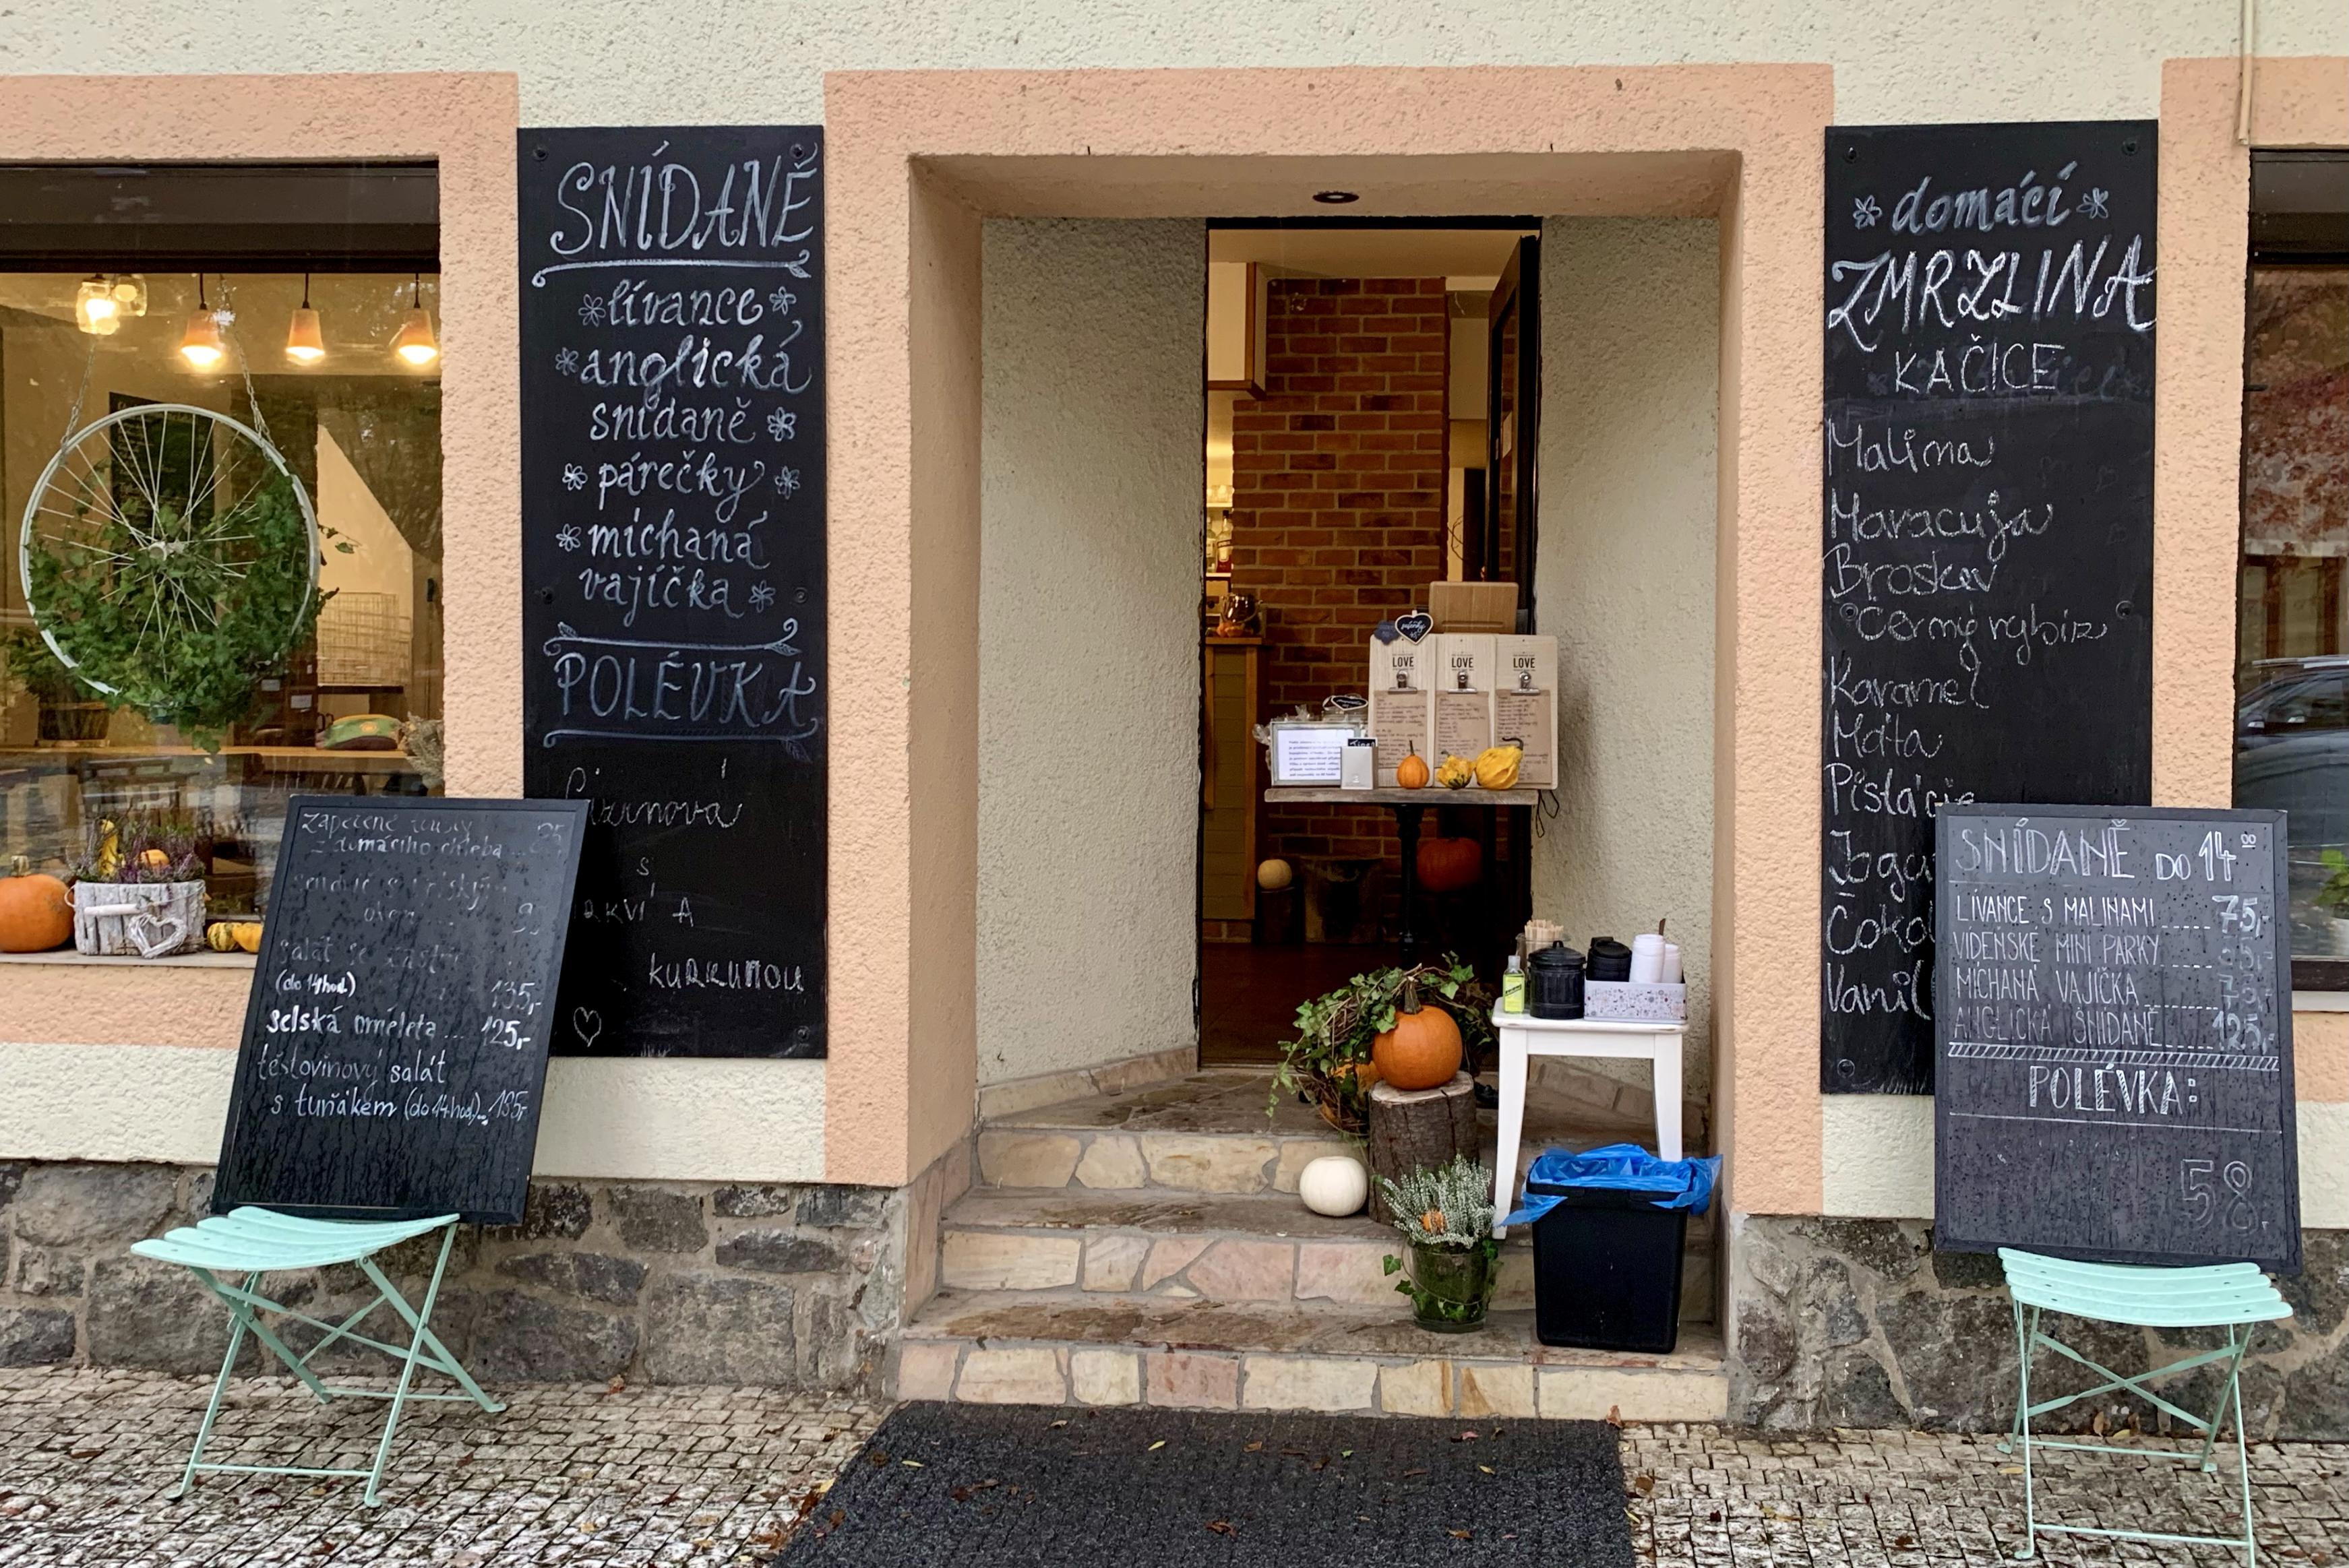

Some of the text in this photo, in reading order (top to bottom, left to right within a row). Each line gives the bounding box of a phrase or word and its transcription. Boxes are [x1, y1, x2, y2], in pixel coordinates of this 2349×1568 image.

[550, 141, 818, 254] SNÍDANĚ
[608, 279, 763, 326] lívance
[1829, 234, 2158, 352] ZMRZLINA
[580, 320, 812, 409] anglická
[1895, 334, 2065, 393] KAČICE
[1828, 418, 1995, 476] Malina
[599, 450, 765, 522] párečky
[588, 508, 770, 569] míchaná
[1831, 489, 2053, 562] Maracuja
[579, 565, 745, 627] vajíčka
[554, 652, 816, 728] POLÉVKA
[1393, 657, 1414, 667] LOVE
[1452, 658, 1473, 668] LOVE
[1513, 658, 1535, 668] LOVE
[1831, 656, 1990, 710] Karamel
[1829, 829, 1936, 903] Jogu
[1955, 817, 2135, 879] SNÍDANĚ
[2156, 853, 2191, 880] DO
[1957, 888, 2030, 924] LÍVANCE
[2041, 898, 2053, 924] S
[2065, 896, 2155, 927] MALINAMI
[1953, 925, 2041, 962] VÍDEŇSKÉ
[2056, 933, 2092, 964] MINI
[1826, 960, 1936, 1020] Vanil
[1957, 961, 2040, 1002] MÍCHANÁ
[2056, 966, 2139, 1006] VAJÍČKA
[390, 1049, 446, 1083] salát
[2030, 1063, 2198, 1116] POLÉVKA:
